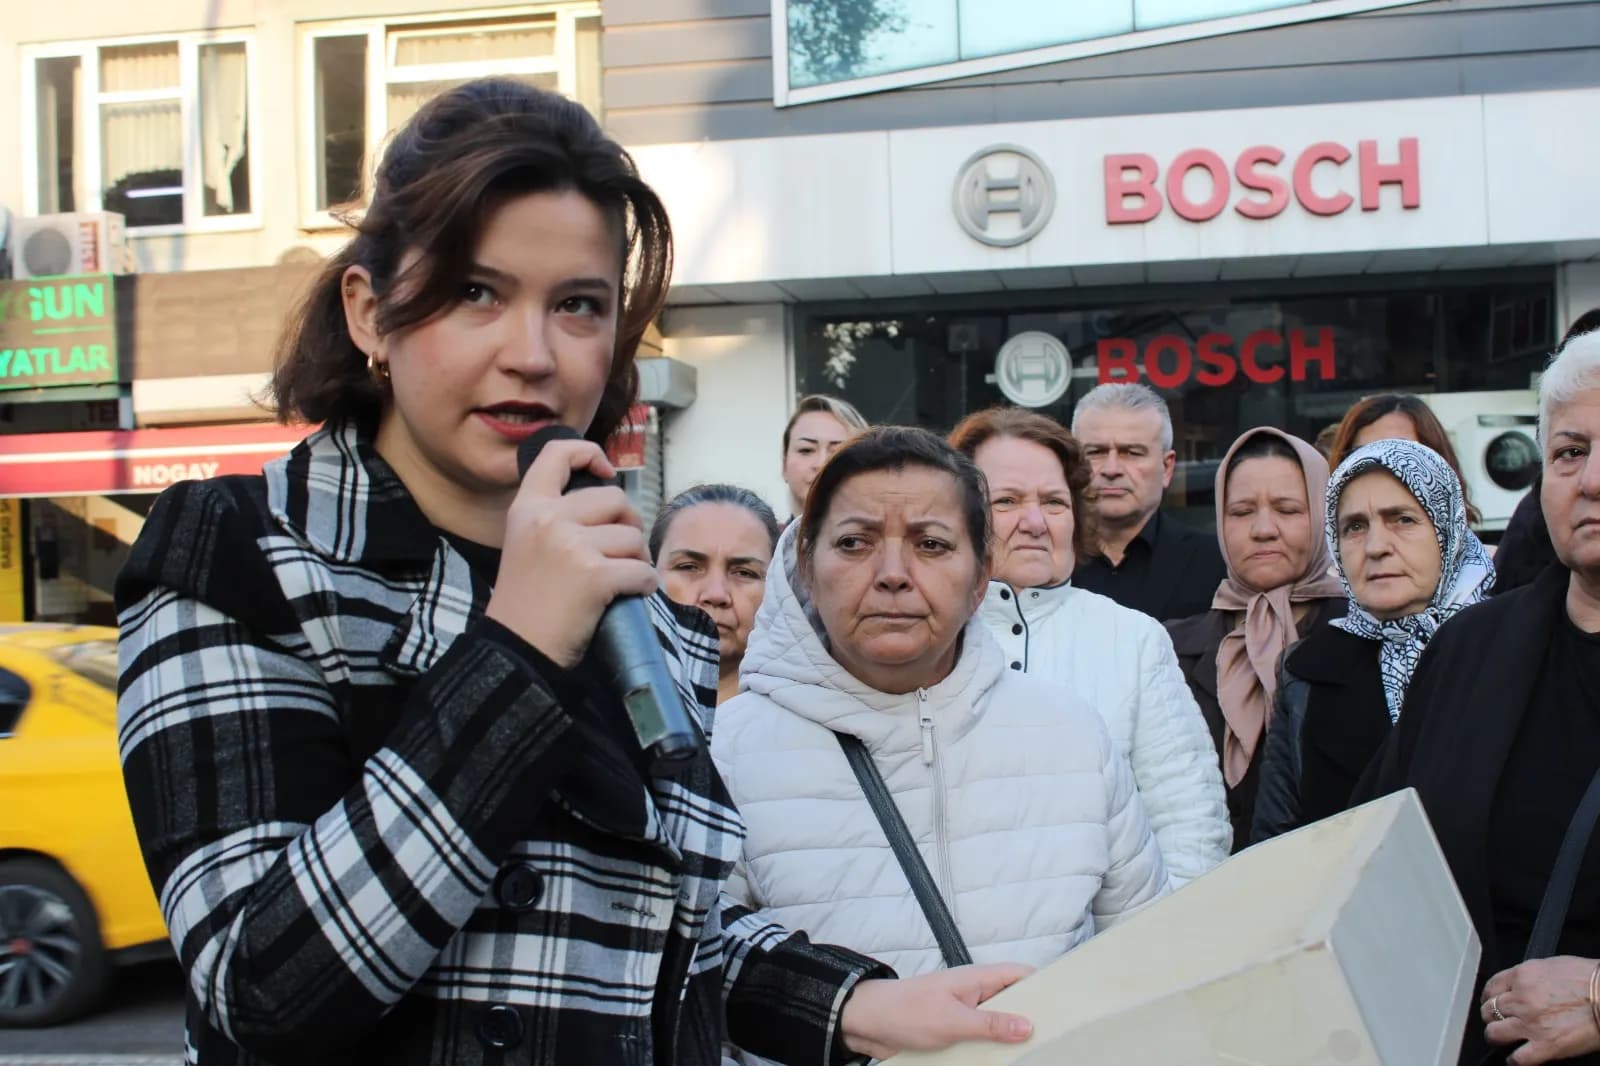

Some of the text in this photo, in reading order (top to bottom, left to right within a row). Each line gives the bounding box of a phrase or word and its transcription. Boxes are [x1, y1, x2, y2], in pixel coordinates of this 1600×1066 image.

[1103, 137, 1421, 225] BOSCH
[1097, 327, 1336, 388] BOSCH
[133, 463, 218, 485] NOGAY
